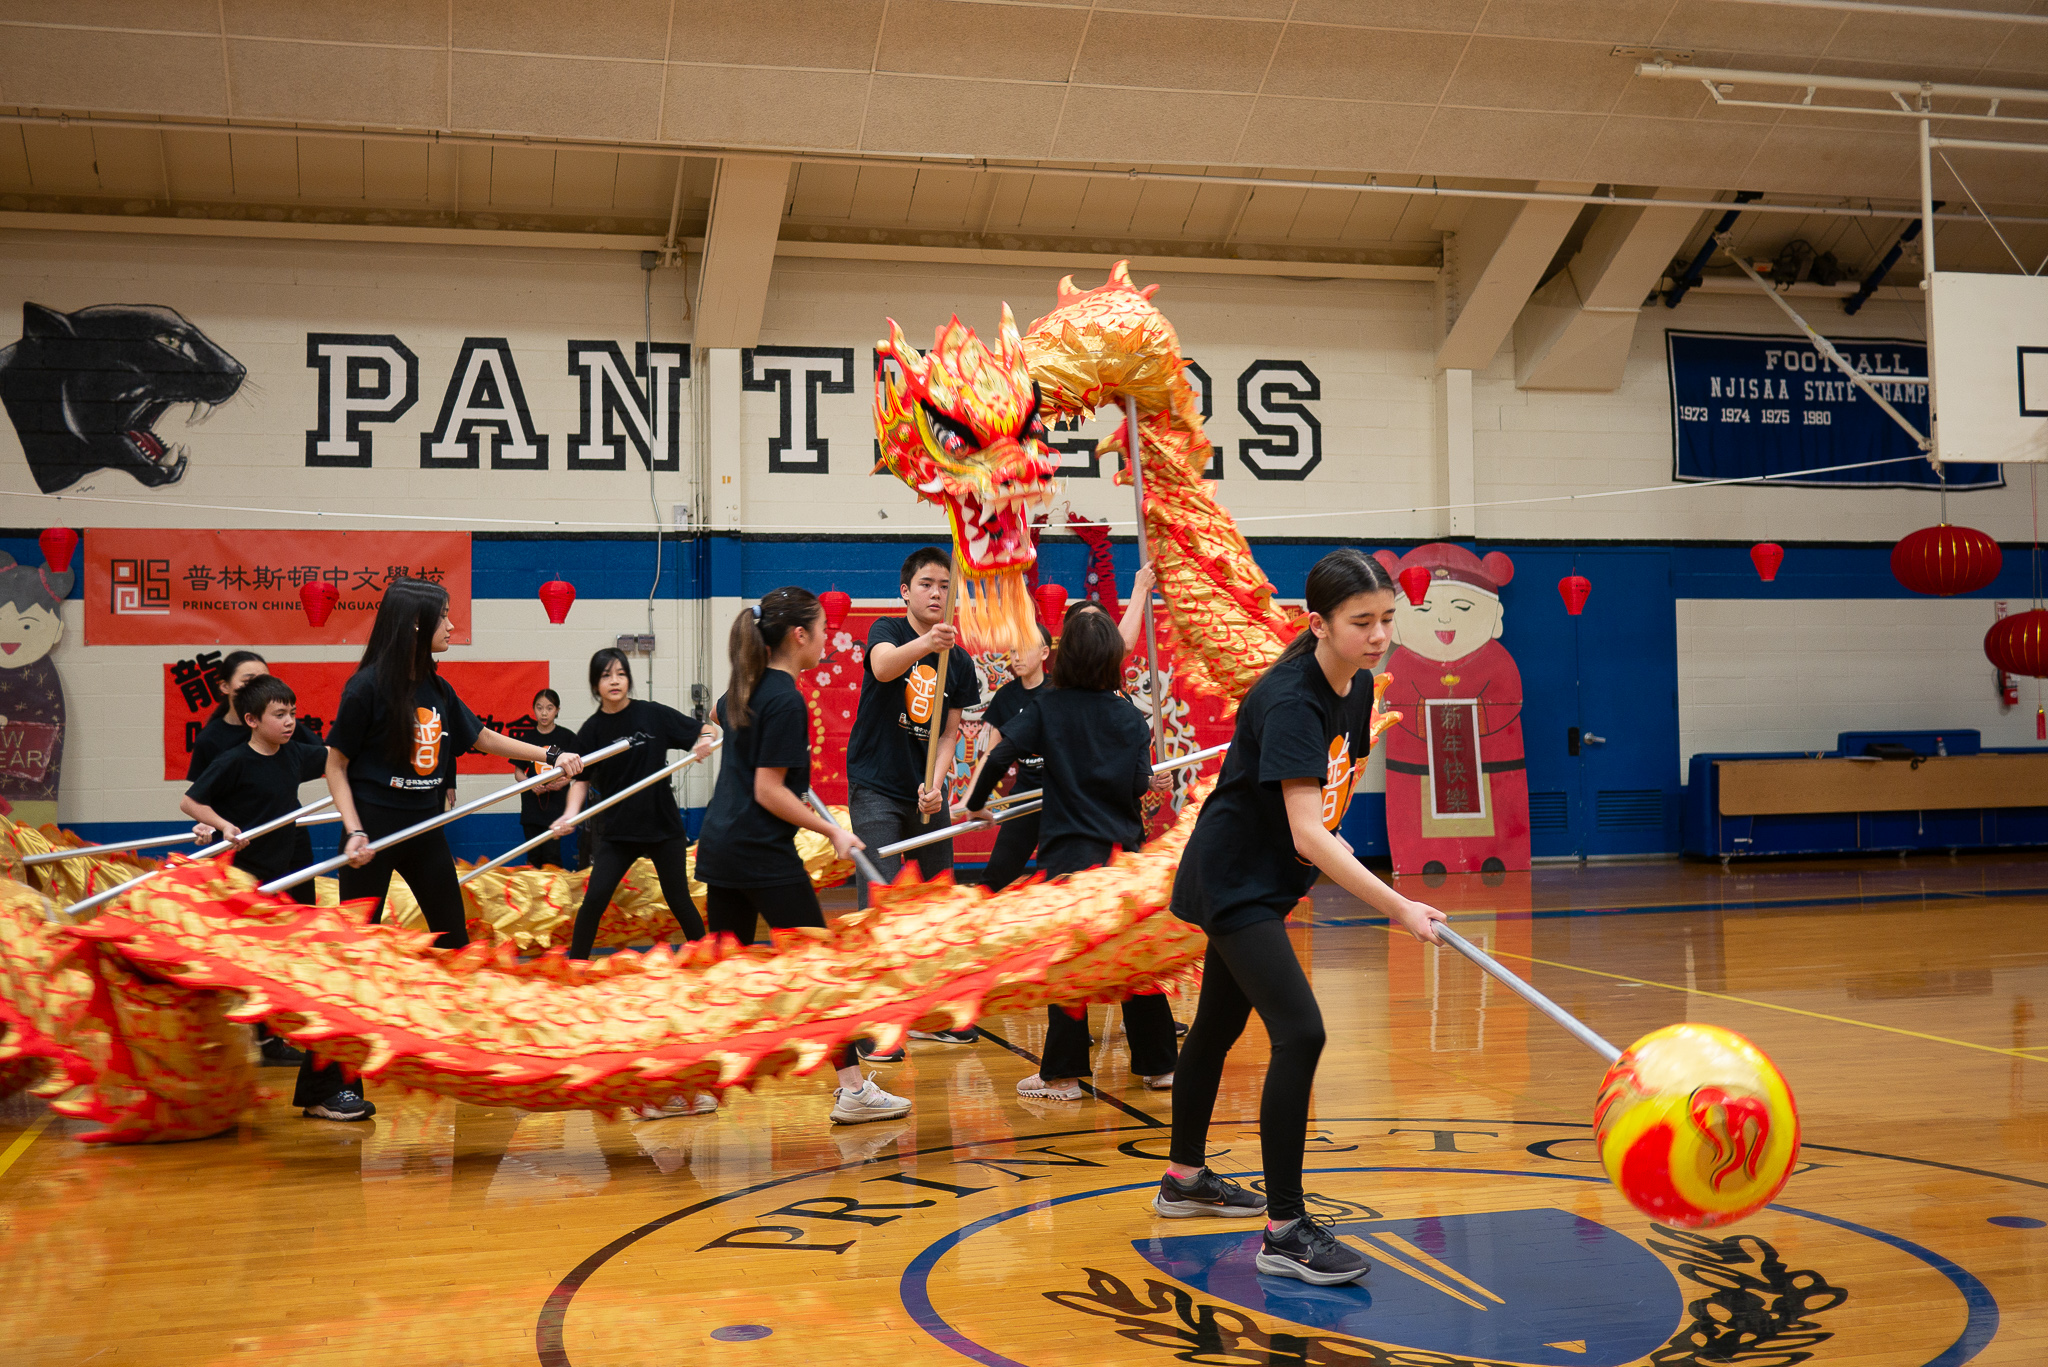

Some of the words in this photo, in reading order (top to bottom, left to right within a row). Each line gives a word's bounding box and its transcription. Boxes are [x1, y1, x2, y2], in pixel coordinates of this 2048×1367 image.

[306, 332, 1321, 480] PANTS
[1679, 405, 1708, 421] 1973
[1721, 407, 1750, 423] 1974
[1761, 409, 1790, 424] 1975
[1803, 410, 1832, 425] 1980
[1711, 376, 1790, 399] NJISAA
[1804, 381, 1857, 402] STATE
[1869, 382, 1929, 404] HAMP
[183, 601, 257, 611] PRINCETON
[263, 601, 302, 611] CHINE
[334, 601, 381, 611] ANGUA
[1441, 703, 1469, 812] 新年快樂
[694, 1128, 1843, 1255] PRINCT
